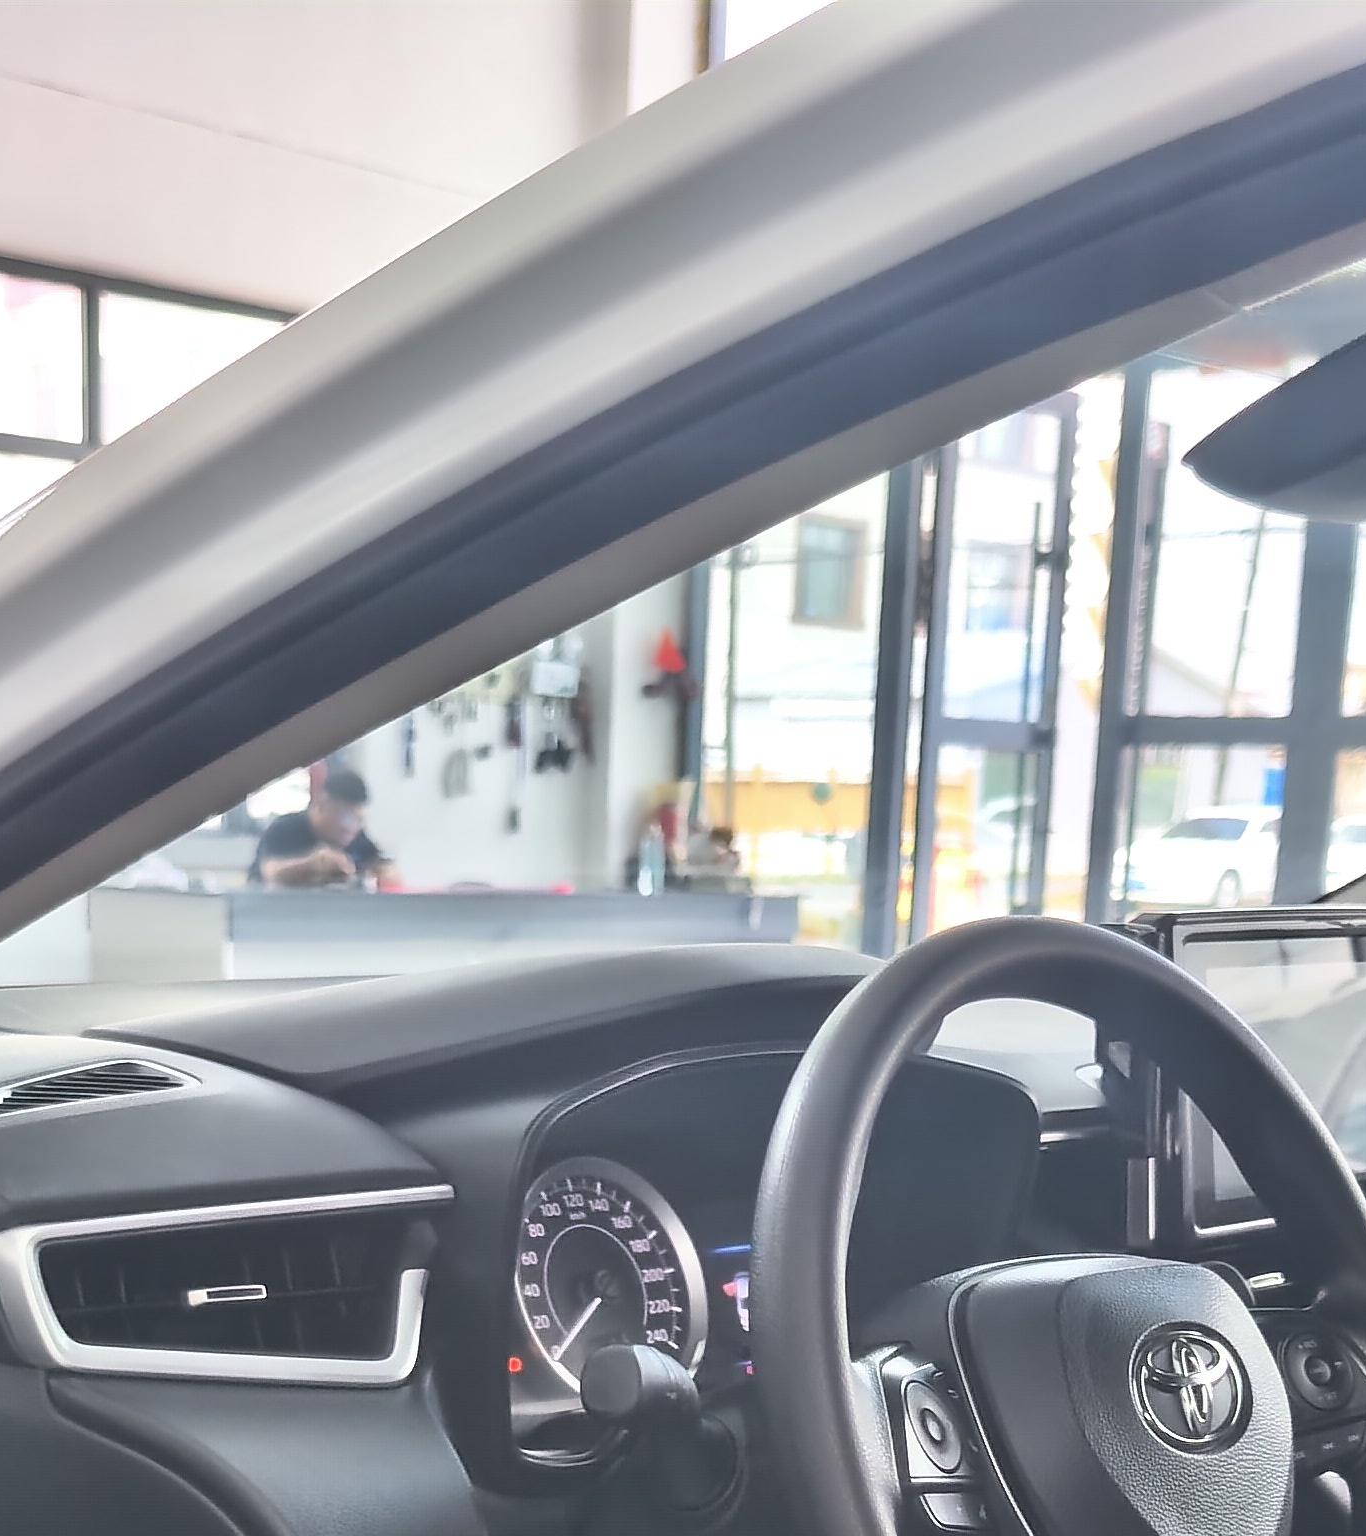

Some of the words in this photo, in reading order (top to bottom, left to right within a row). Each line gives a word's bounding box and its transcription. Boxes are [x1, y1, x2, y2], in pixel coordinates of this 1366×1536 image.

[562, 1194, 584, 1208] 120
[589, 1198, 610, 1212] 140
[539, 1203, 562, 1217] 100
[528, 1223, 546, 1238] 80
[521, 1250, 539, 1266] 60
[524, 1283, 541, 1297] 40
[647, 1299, 671, 1314] 220
[533, 1314, 551, 1330] 20
[645, 1328, 669, 1344] 240
